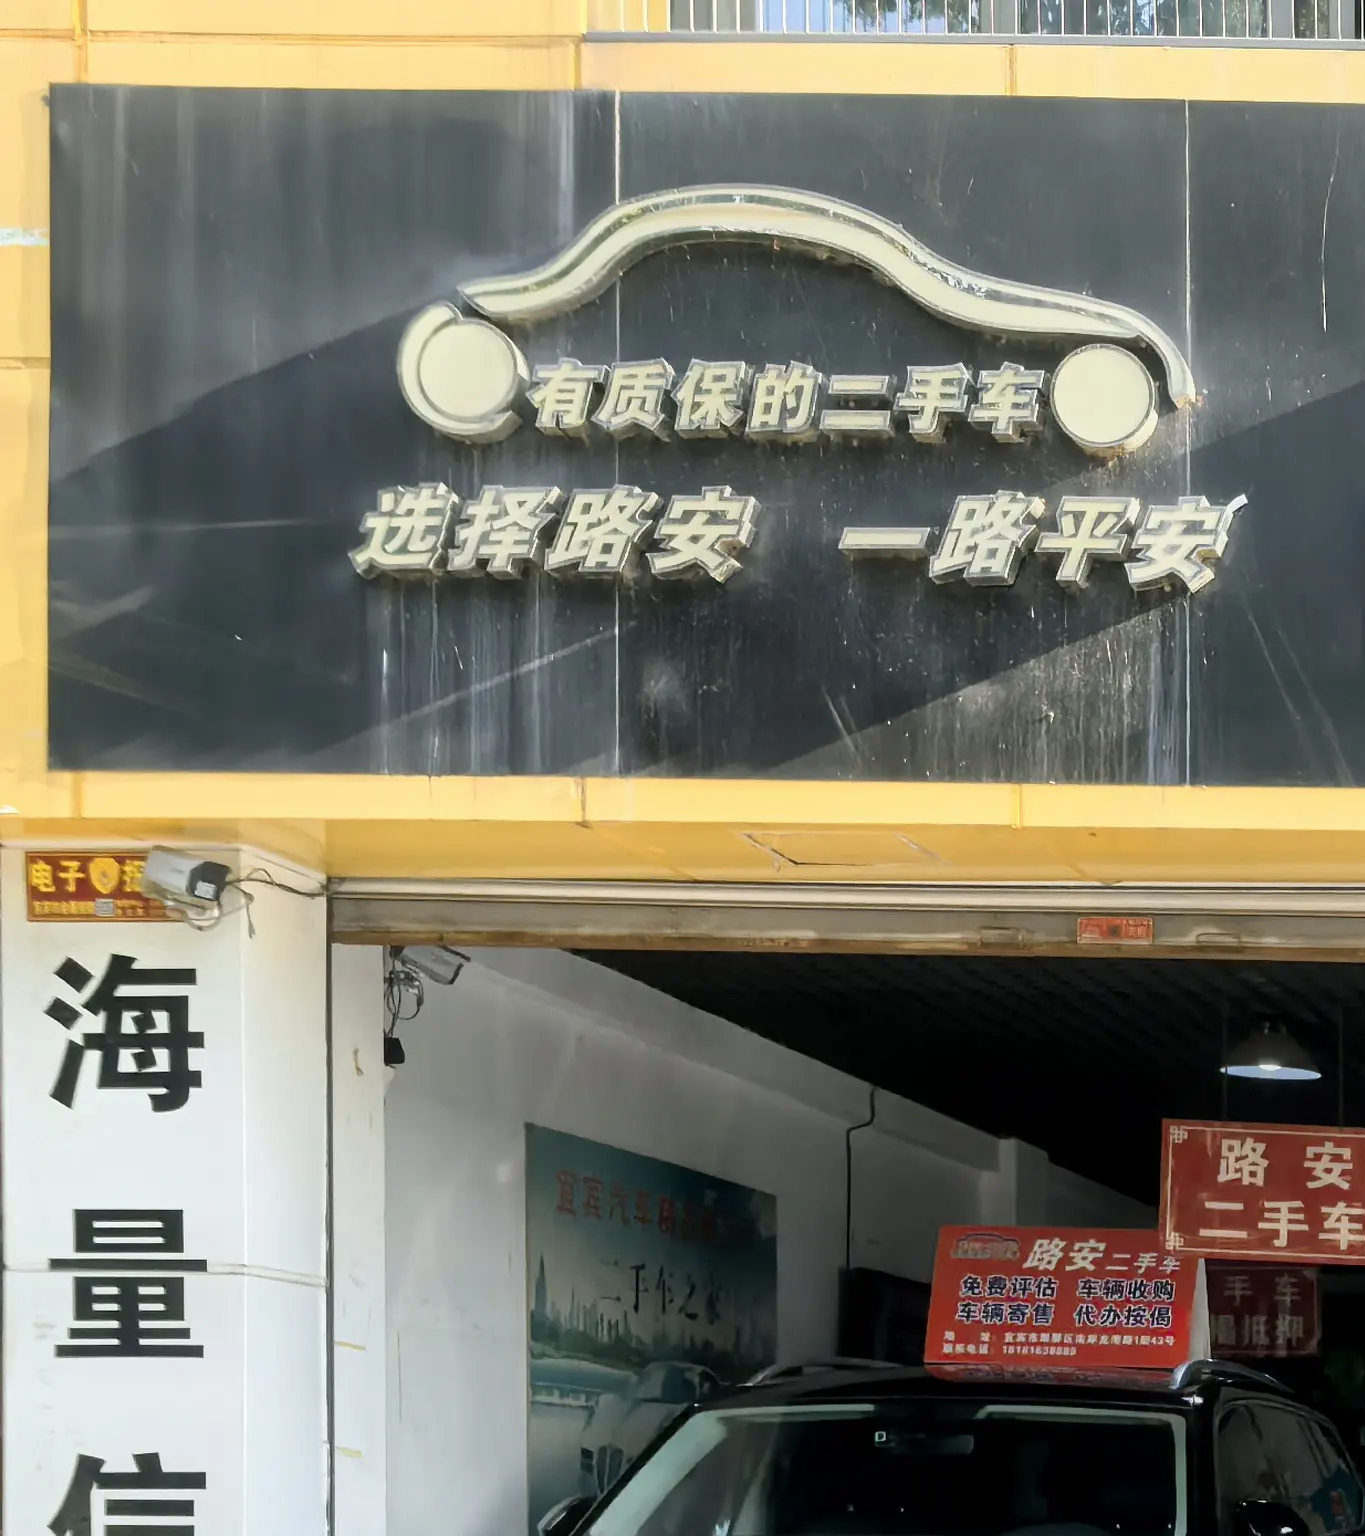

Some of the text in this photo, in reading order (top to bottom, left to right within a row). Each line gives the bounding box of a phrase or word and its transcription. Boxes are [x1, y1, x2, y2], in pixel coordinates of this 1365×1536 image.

[527, 357, 1048, 444] 有质保的二手车
[349, 482, 1247, 593] 选择路安 一路平安
[1217, 1138, 1354, 1190] 路安
[1199, 1200, 1365, 1250] 二手车
[956, 1301, 1055, 1327] 车辆寄售
[960, 1274, 1175, 1303] 免费评估 车辆收购
